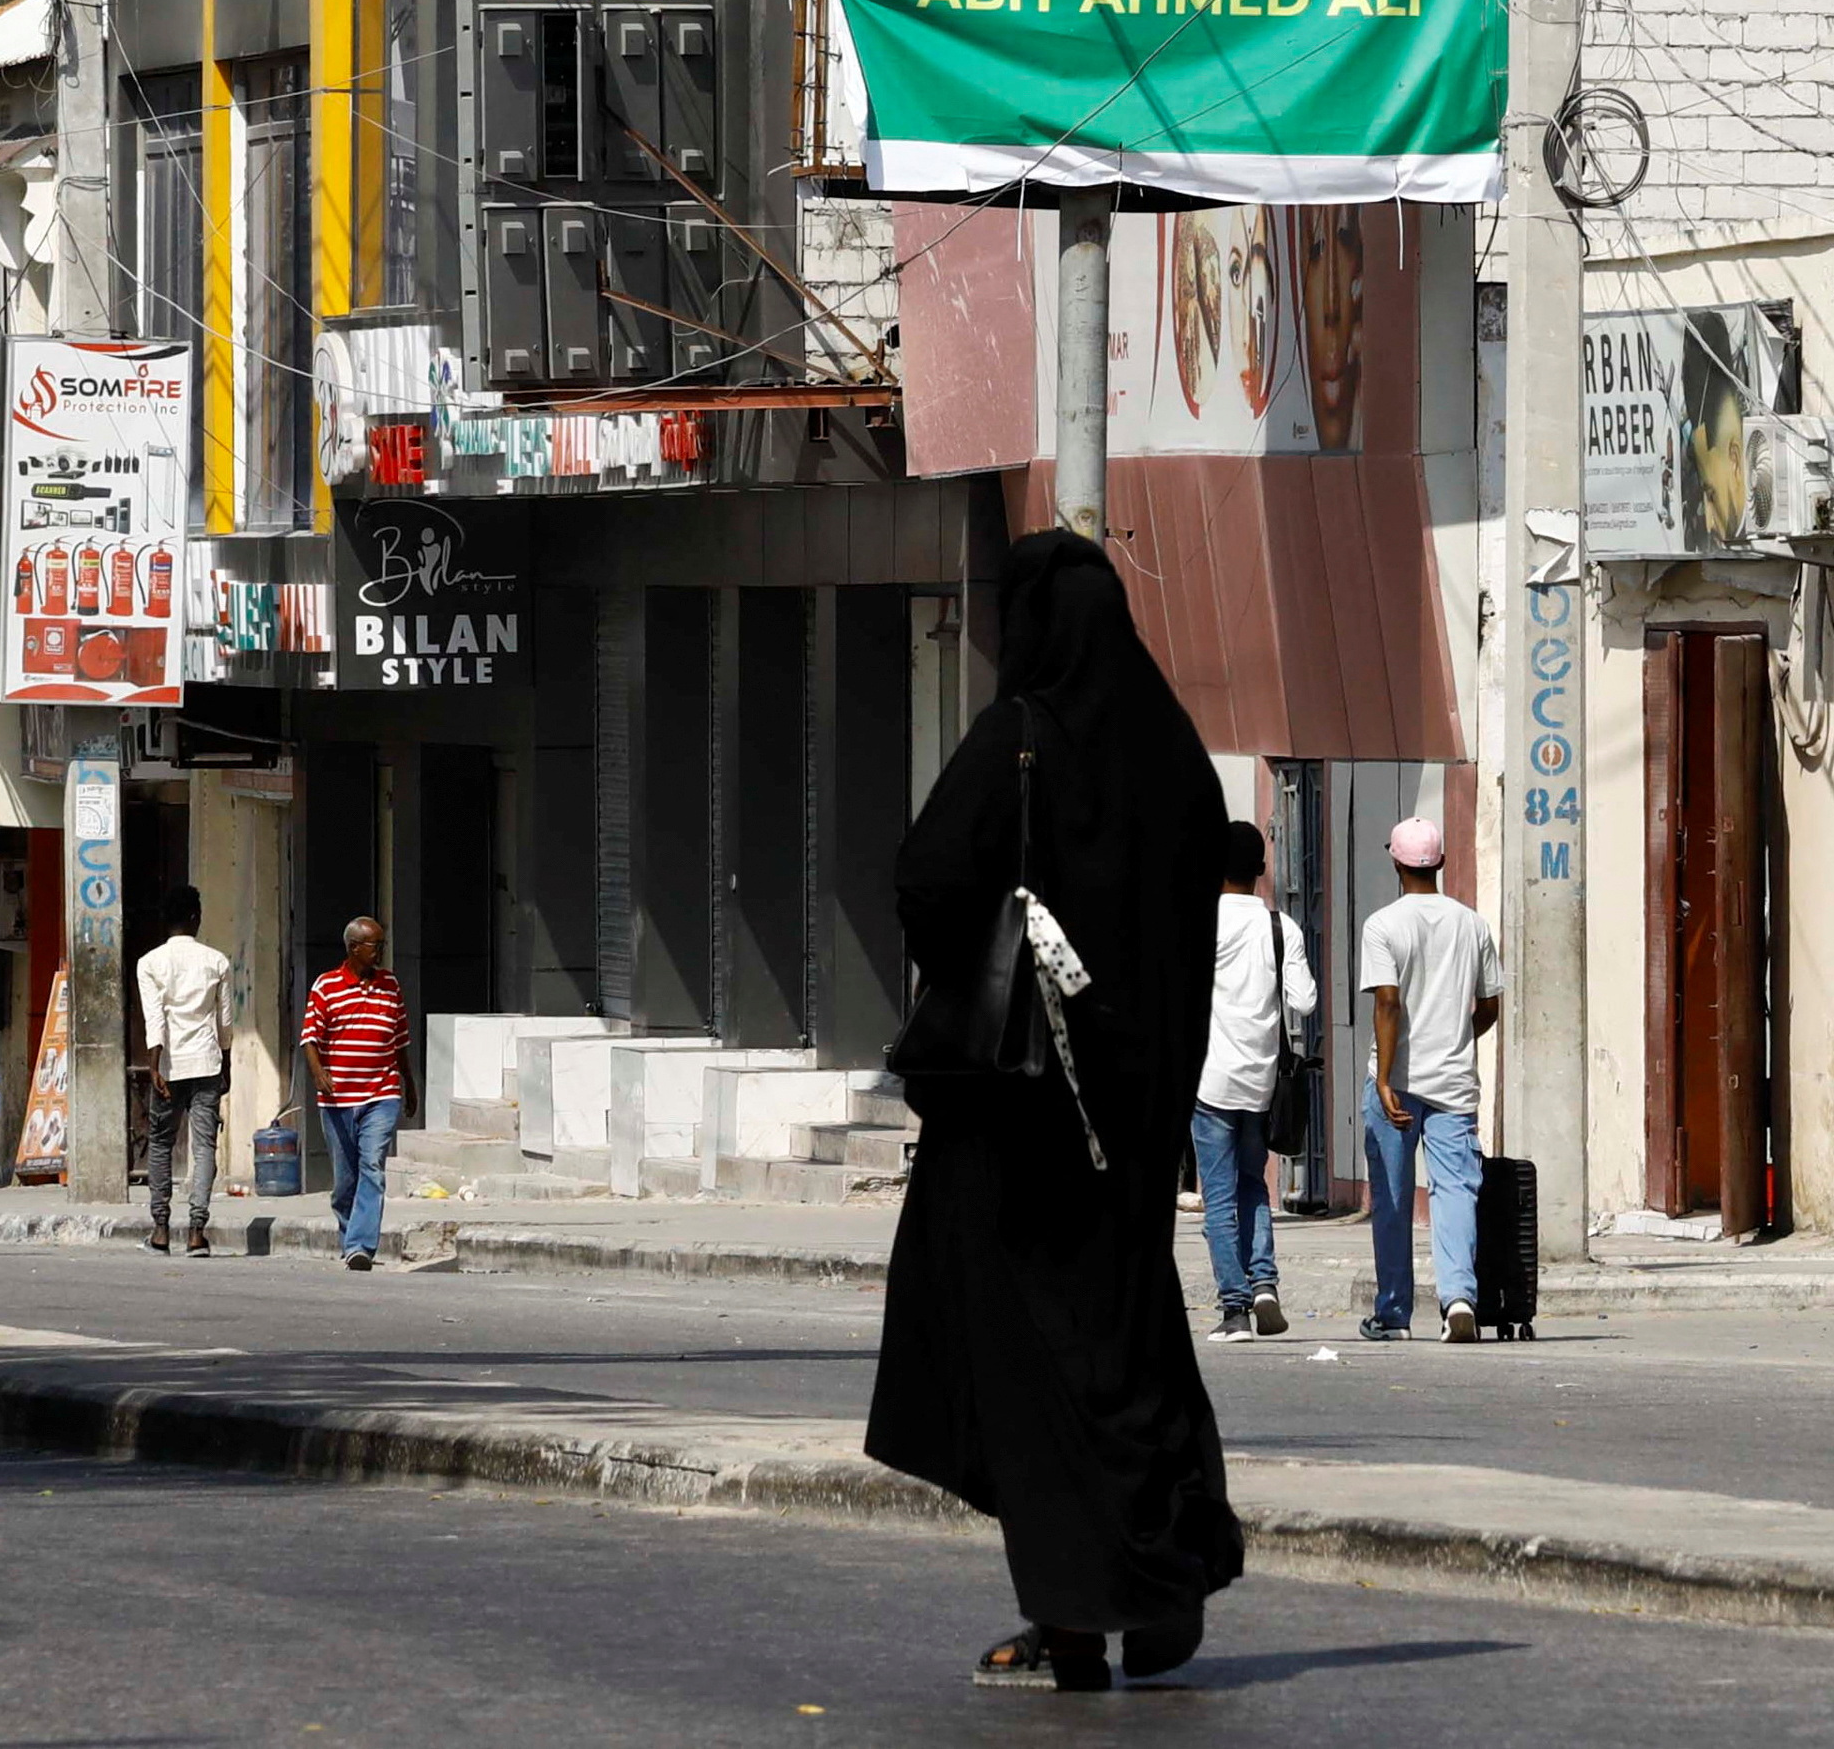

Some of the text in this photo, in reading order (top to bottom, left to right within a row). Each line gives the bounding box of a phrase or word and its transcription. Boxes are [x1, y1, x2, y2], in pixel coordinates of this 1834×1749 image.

[60, 377, 182, 399] SOMFIRE
[63, 399, 178, 415] Protection Inc
[1588, 403, 1655, 456] ARBER
[461, 581, 516, 594] style
[355, 613, 518, 656] BILAN
[382, 656, 493, 685] STYLE
[1525, 787, 1581, 826] 84
[1540, 841, 1570, 879] M
